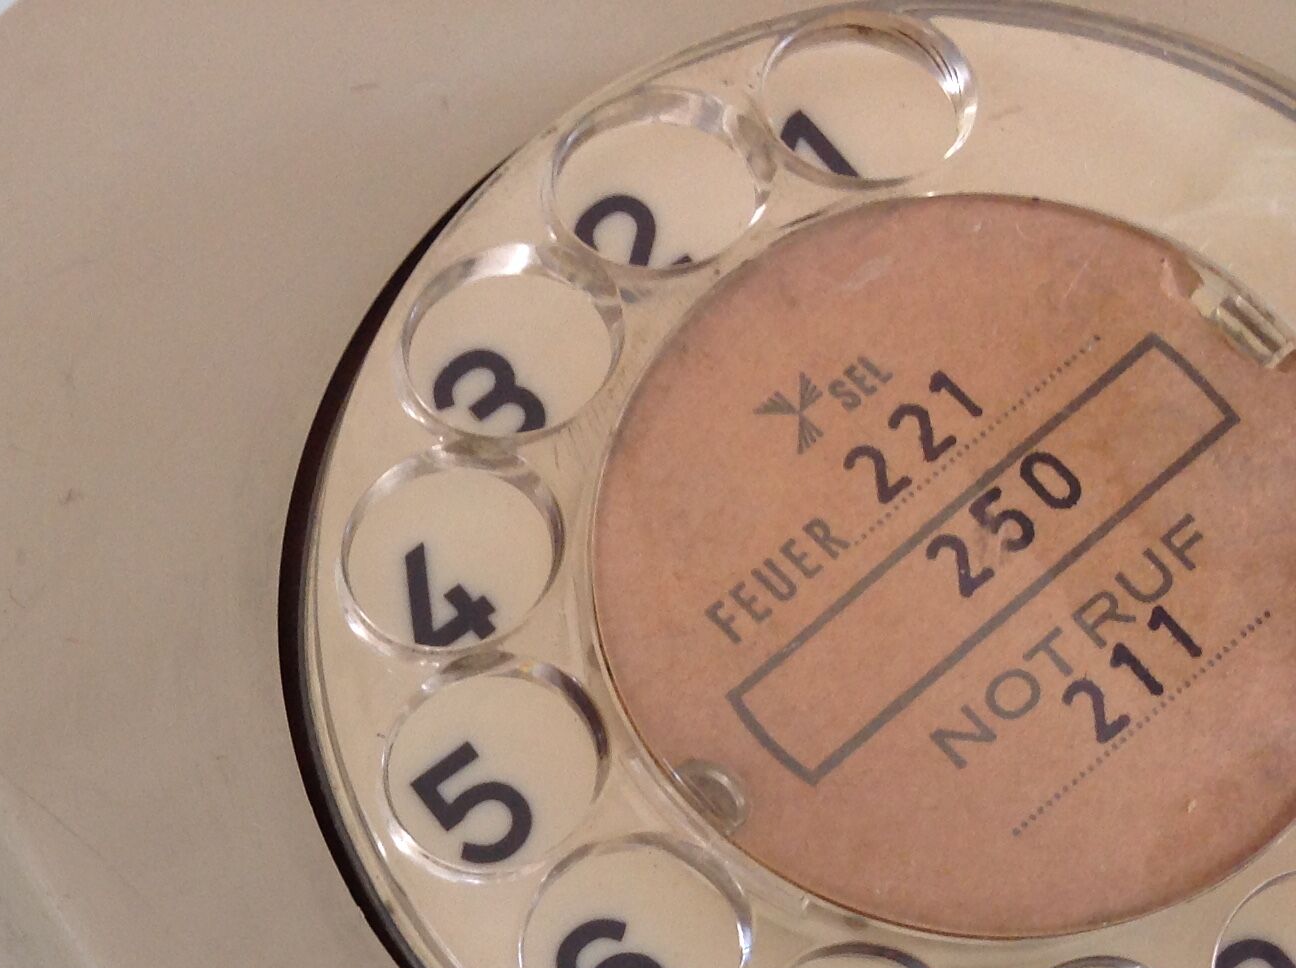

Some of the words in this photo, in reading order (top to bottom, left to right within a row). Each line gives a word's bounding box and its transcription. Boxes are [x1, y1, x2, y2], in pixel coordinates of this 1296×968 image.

[574, 193, 692, 268] 2
[433, 348, 546, 432] 3
[827, 355, 894, 411] SEL
[704, 517, 851, 645] FEUER
[843, 370, 983, 503] 221
[926, 451, 1082, 597] 250
[405, 544, 496, 647] 4
[930, 513, 1205, 769] NOTRUF
[1061, 605, 1202, 743] 211
[411, 742, 533, 865] 5
